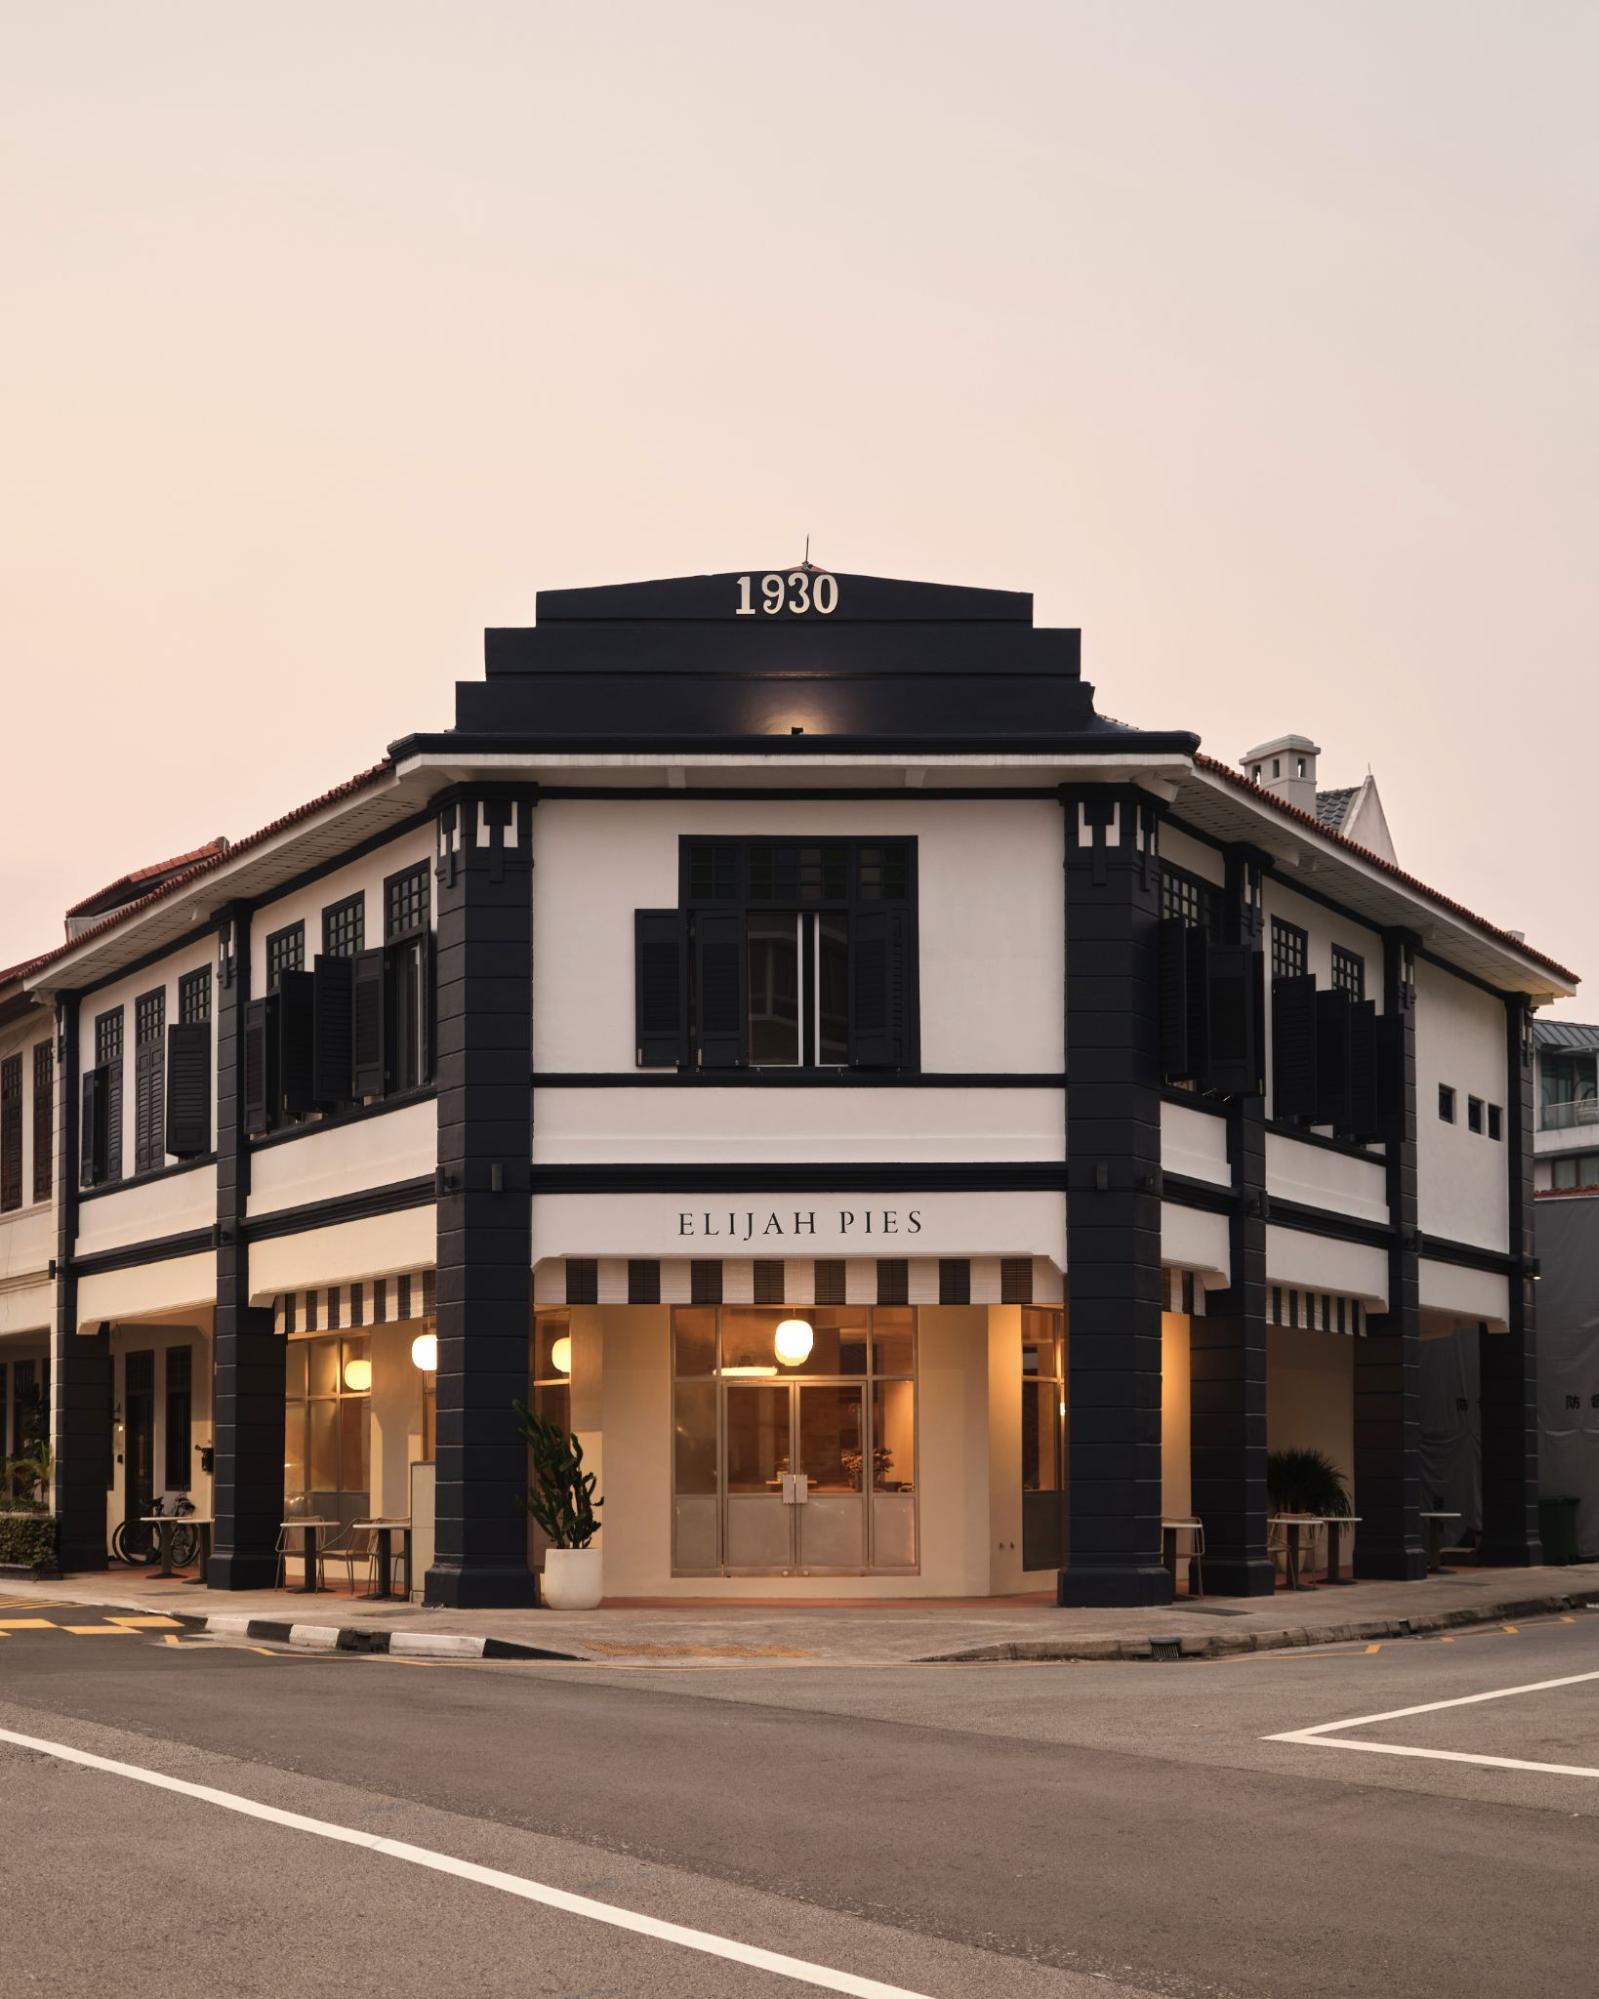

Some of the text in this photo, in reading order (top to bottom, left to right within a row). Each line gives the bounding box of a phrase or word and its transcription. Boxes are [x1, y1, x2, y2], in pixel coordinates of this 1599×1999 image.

[736, 572, 838, 614] 1930
[678, 1210, 922, 1241] ELIJAH PIES
